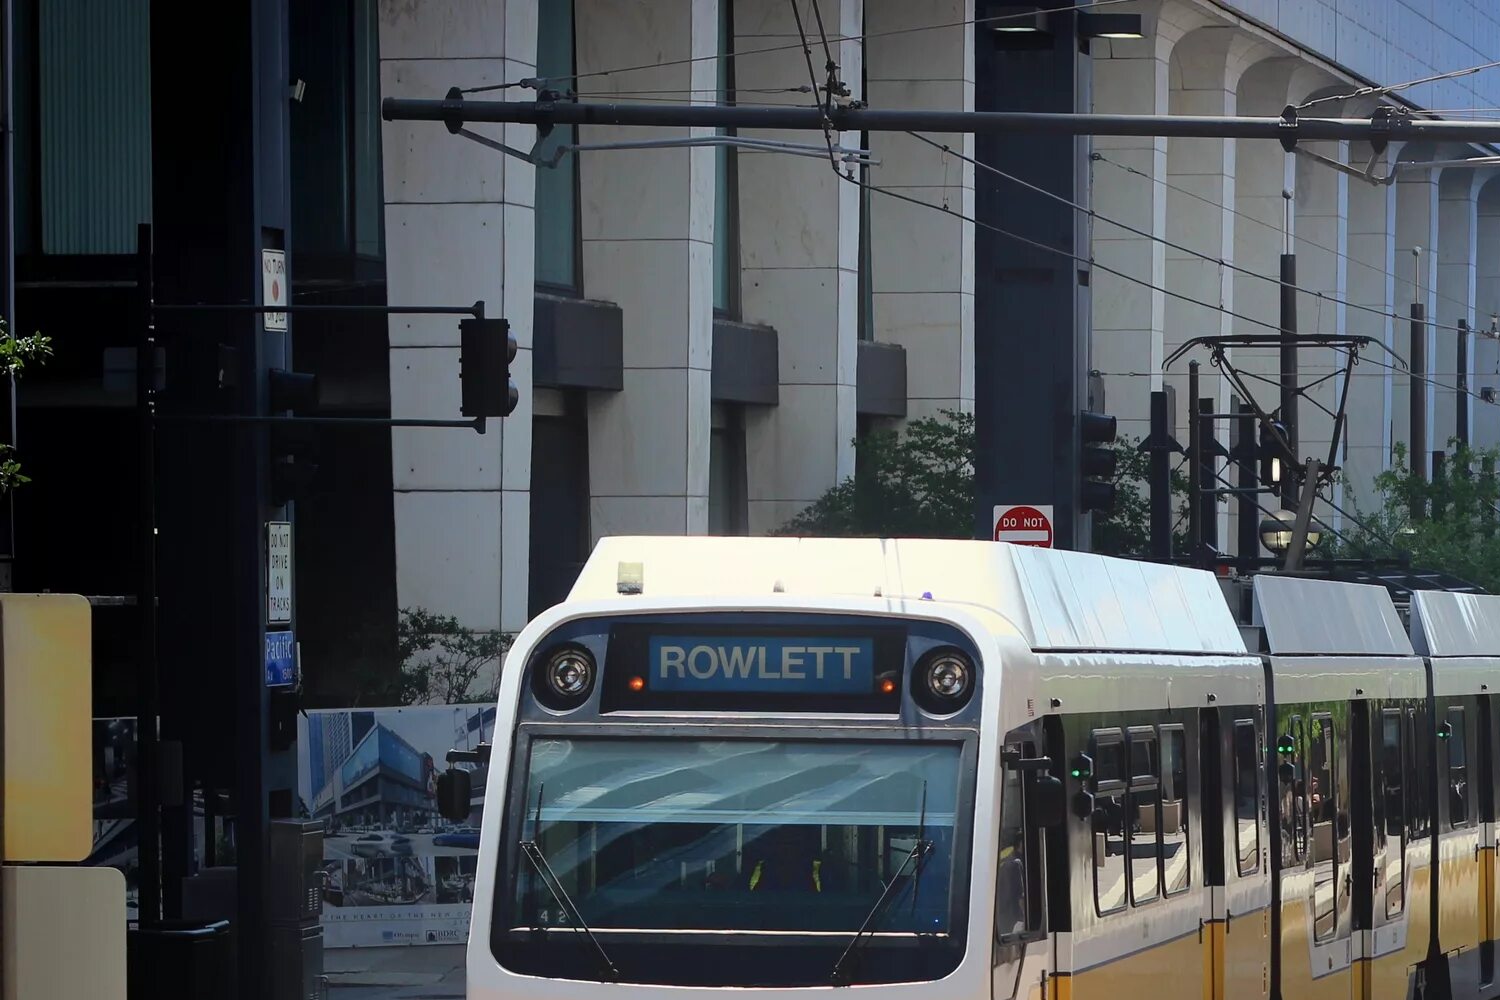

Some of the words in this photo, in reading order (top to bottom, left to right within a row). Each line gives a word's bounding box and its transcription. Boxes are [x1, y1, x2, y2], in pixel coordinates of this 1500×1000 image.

[264, 259, 272, 273] NO
[1003, 518, 1017, 527] DO
[1023, 517, 1044, 527] NOT
[271, 534, 278, 548] DO
[279, 534, 289, 548] NOT
[272, 554, 288, 569] DRIVE
[276, 575, 284, 590] ON
[270, 597, 290, 611] TRACKS
[266, 635, 292, 660] Pacific
[659, 645, 861, 680] ROWLETT
[540, 910, 549, 922] 4
